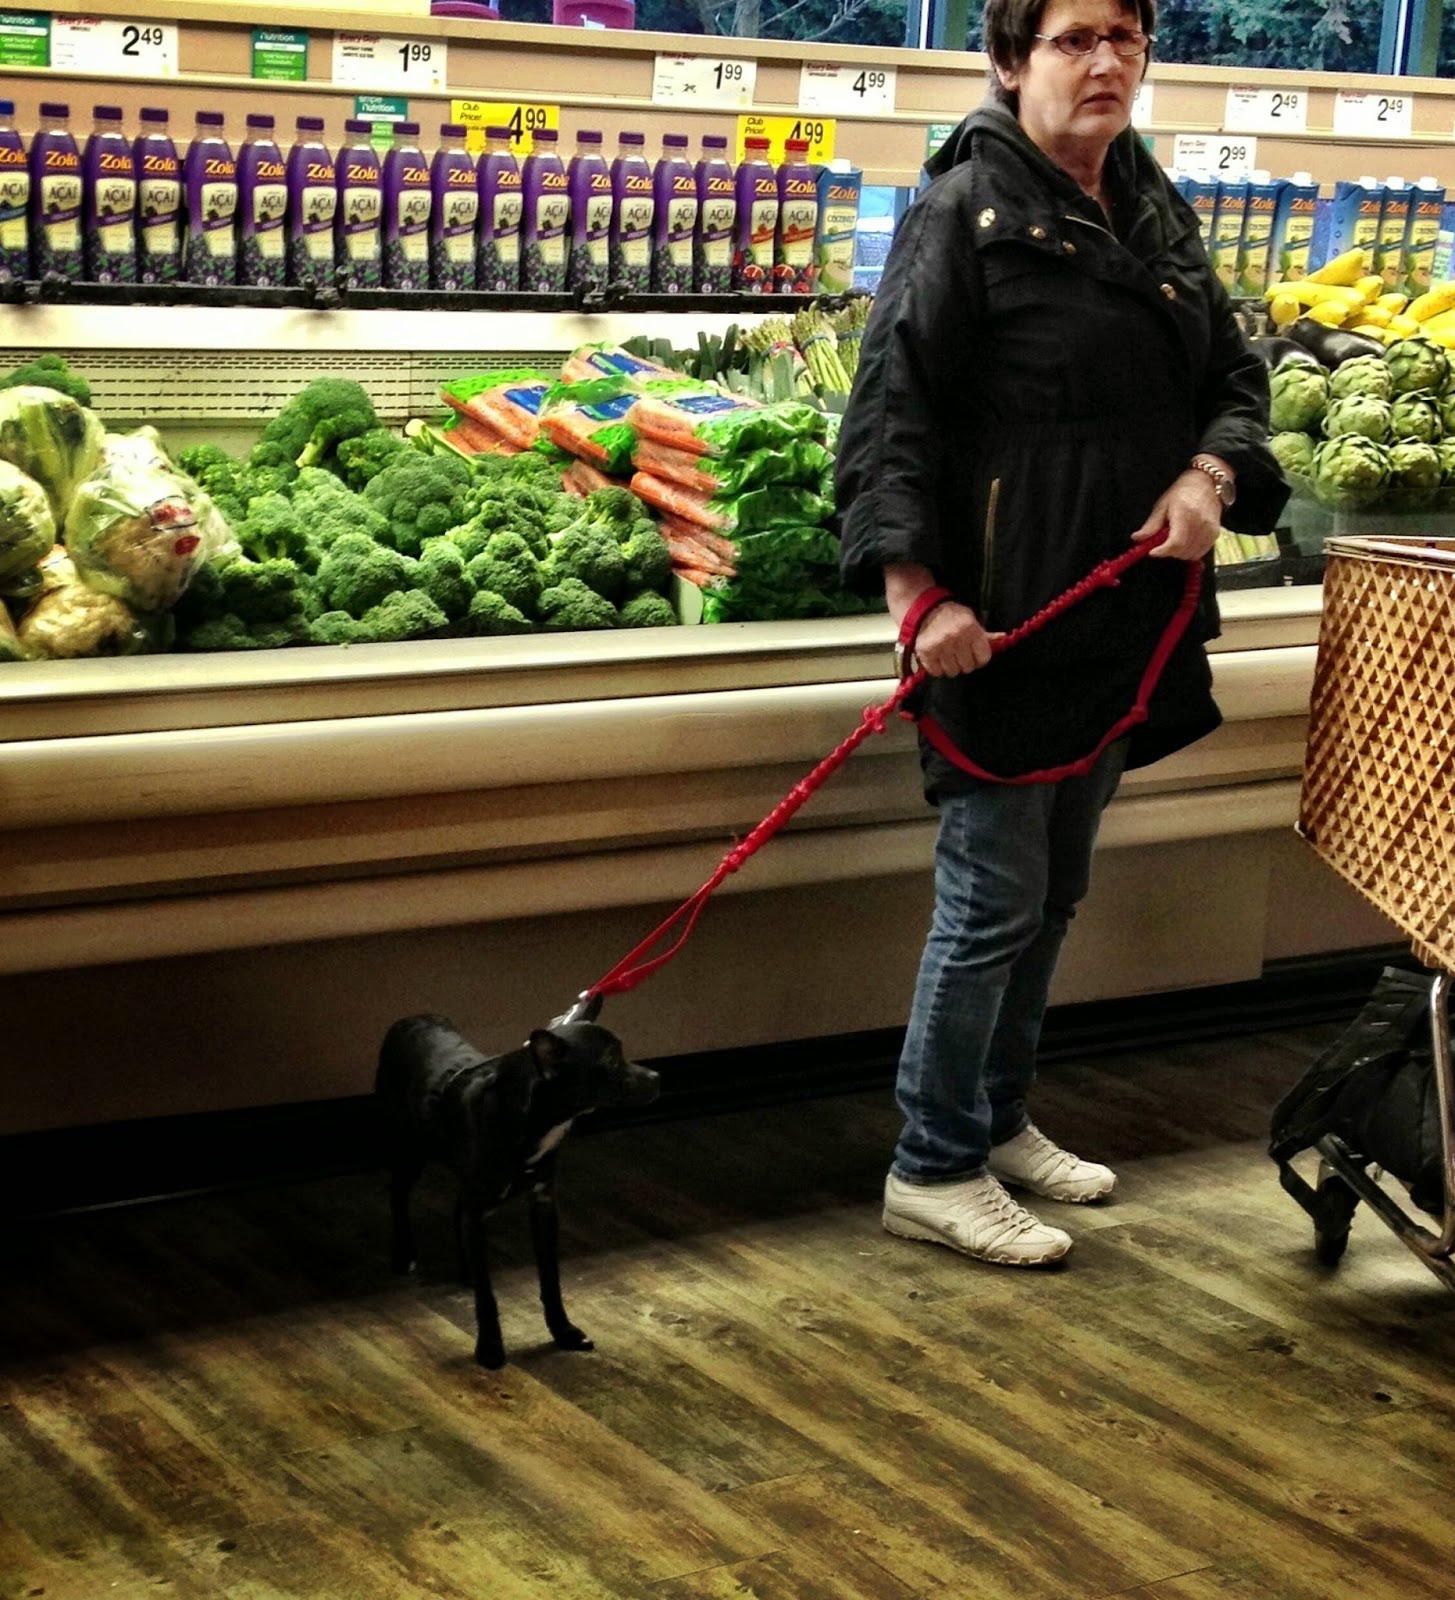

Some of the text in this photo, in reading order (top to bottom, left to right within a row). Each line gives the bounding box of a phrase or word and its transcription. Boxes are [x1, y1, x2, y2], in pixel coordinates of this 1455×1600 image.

[462, 102, 480, 111] Club
[747, 117, 764, 126] Club
[46, 151, 79, 167] Zola
[100, 153, 133, 170] Zola
[144, 155, 178, 172] Zola
[205, 159, 235, 175] Zola
[256, 161, 286, 177] Zola
[347, 164, 379, 180] Zola
[447, 168, 478, 184] Zola
[785, 179, 817, 194] Zola
[828, 185, 859, 201] Zola
